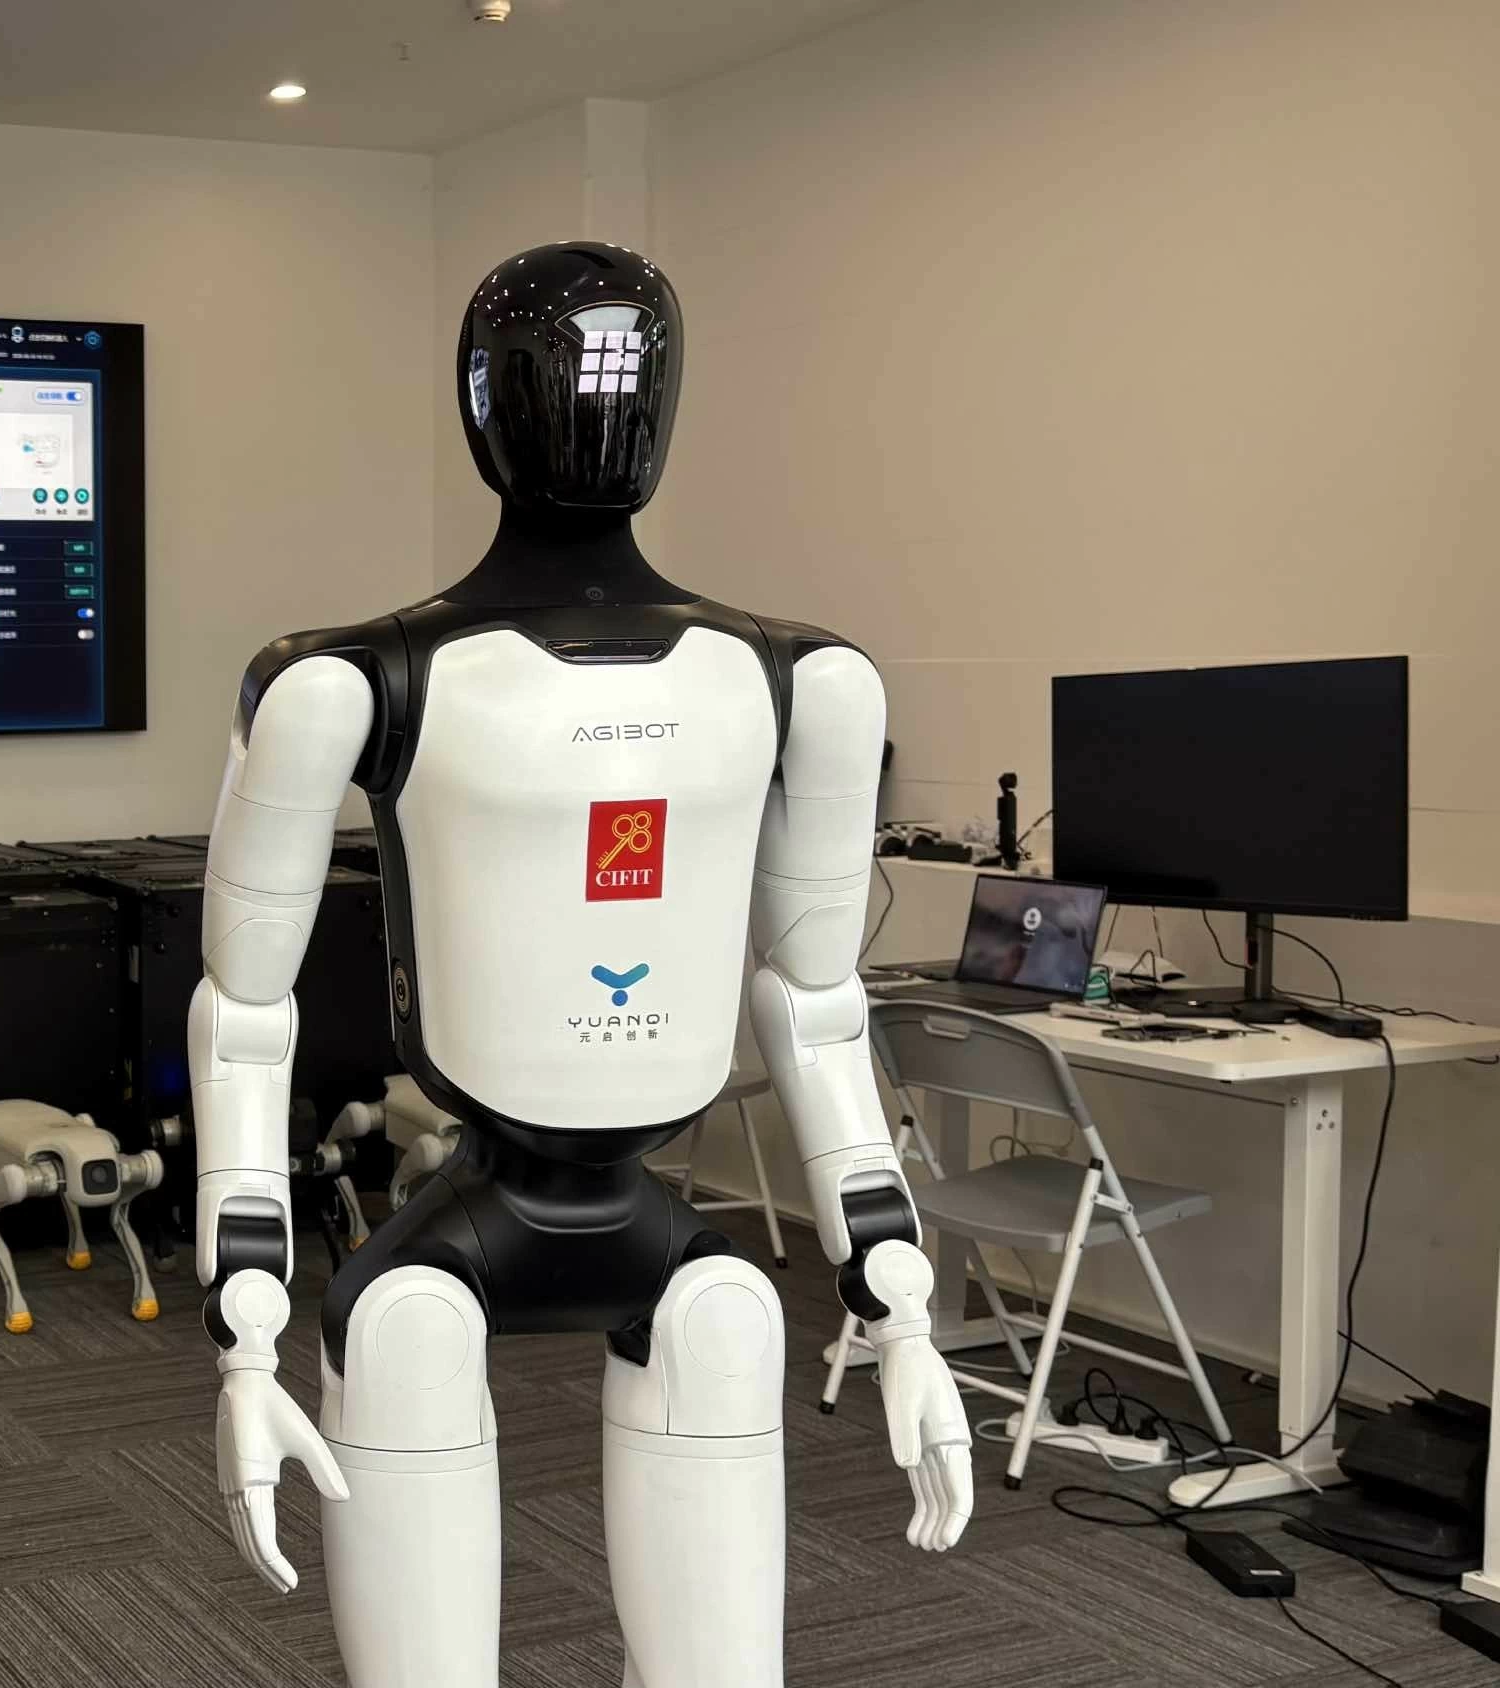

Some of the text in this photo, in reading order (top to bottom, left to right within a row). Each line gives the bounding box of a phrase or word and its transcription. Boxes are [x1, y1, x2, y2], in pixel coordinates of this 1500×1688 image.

[571, 723, 680, 743] AGIBOT
[595, 868, 653, 887] CIFIT
[567, 1012, 669, 1029] YUANQI
[579, 1028, 658, 1043] 元启创新
